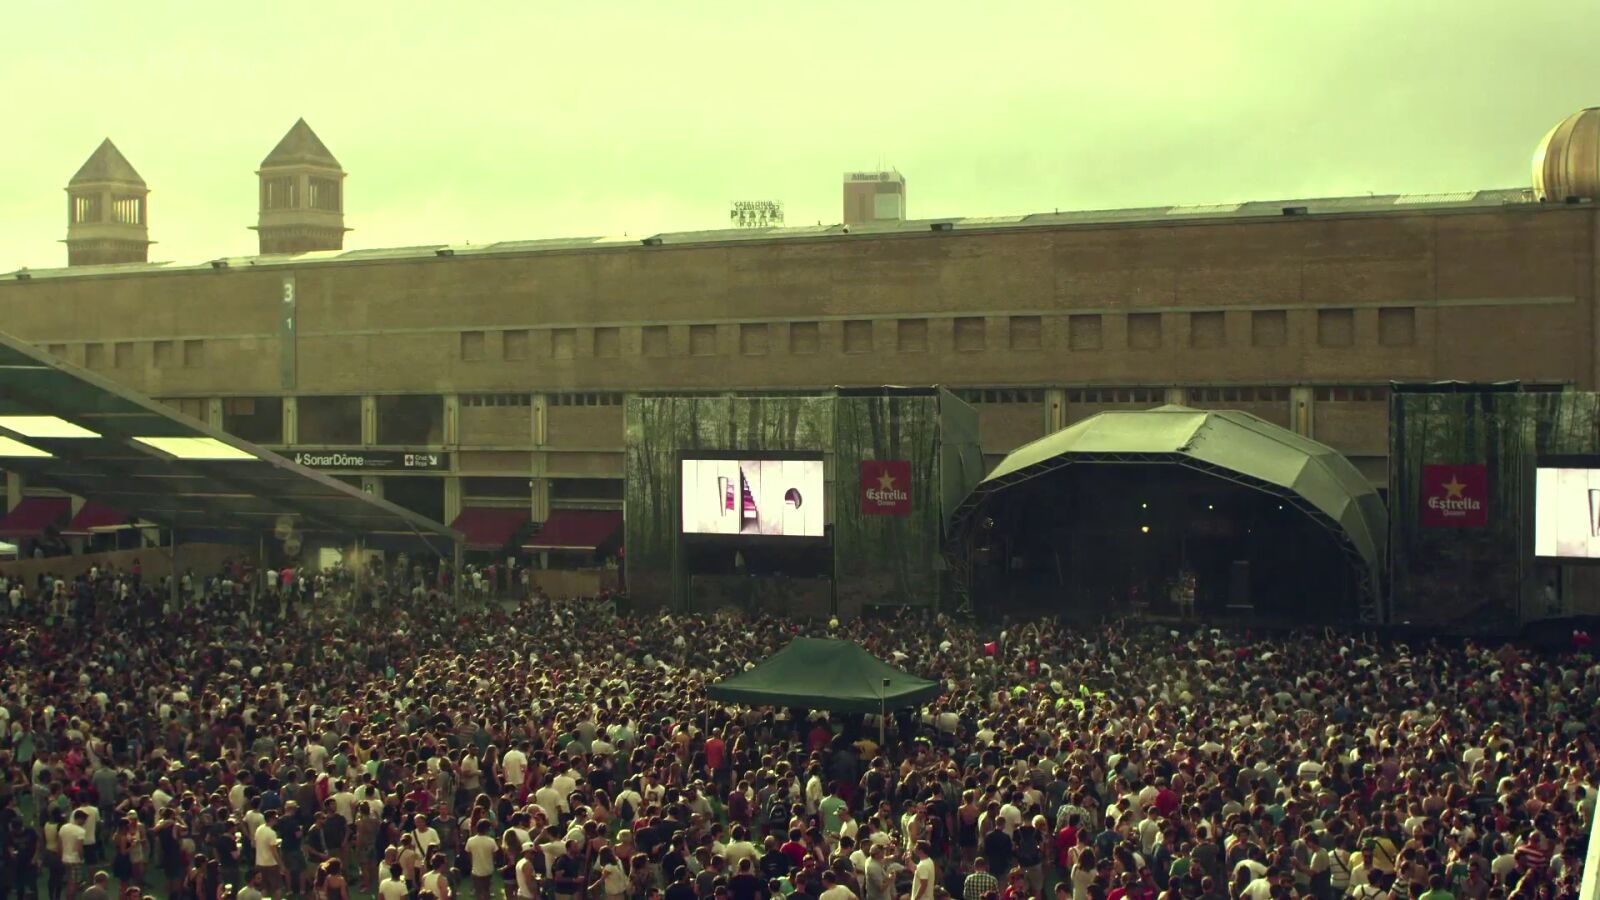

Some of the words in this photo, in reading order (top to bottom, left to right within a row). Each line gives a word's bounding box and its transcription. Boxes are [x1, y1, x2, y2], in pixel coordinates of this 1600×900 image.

[731, 210, 777, 219] PLAZA
[284, 283, 293, 302] 3
[286, 318, 292, 329] 1
[866, 488, 907, 501] Estrella
[1428, 496, 1481, 510] Estrella
